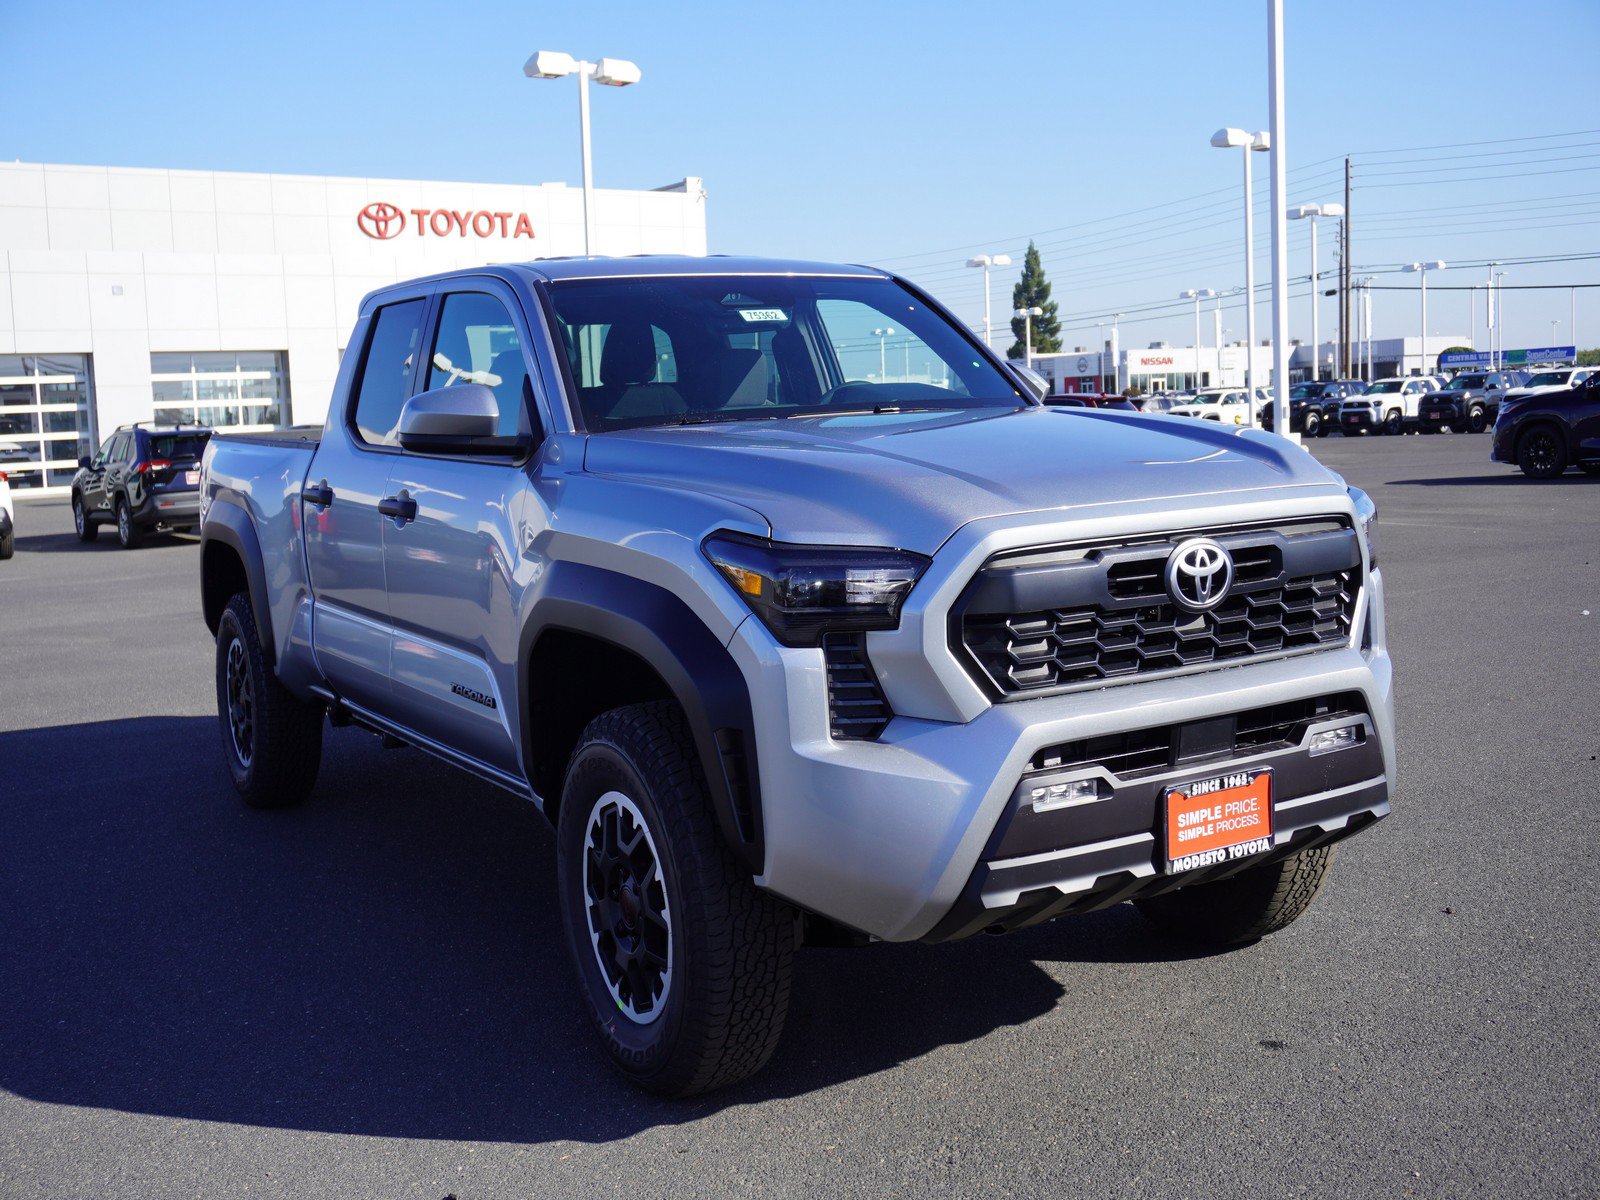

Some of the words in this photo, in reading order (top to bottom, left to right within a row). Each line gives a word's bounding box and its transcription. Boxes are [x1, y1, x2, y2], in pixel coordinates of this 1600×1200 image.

[411, 209, 535, 239] TOYOTA
[746, 311, 780, 320] 75362
[1141, 357, 1173, 365] NISSAN
[449, 682, 497, 709] TACOMA
[1192, 779, 1220, 796] SINCE
[1223, 773, 1247, 789] 1965
[1177, 805, 1222, 828] SIMPLE
[1225, 797, 1260, 817] PRICE.
[1177, 824, 1214, 842] SIMPLE
[1216, 813, 1260, 833] PROCESS.
[1173, 849, 1226, 873] MODESTO
[1228, 838, 1271, 856] TOYOTA
